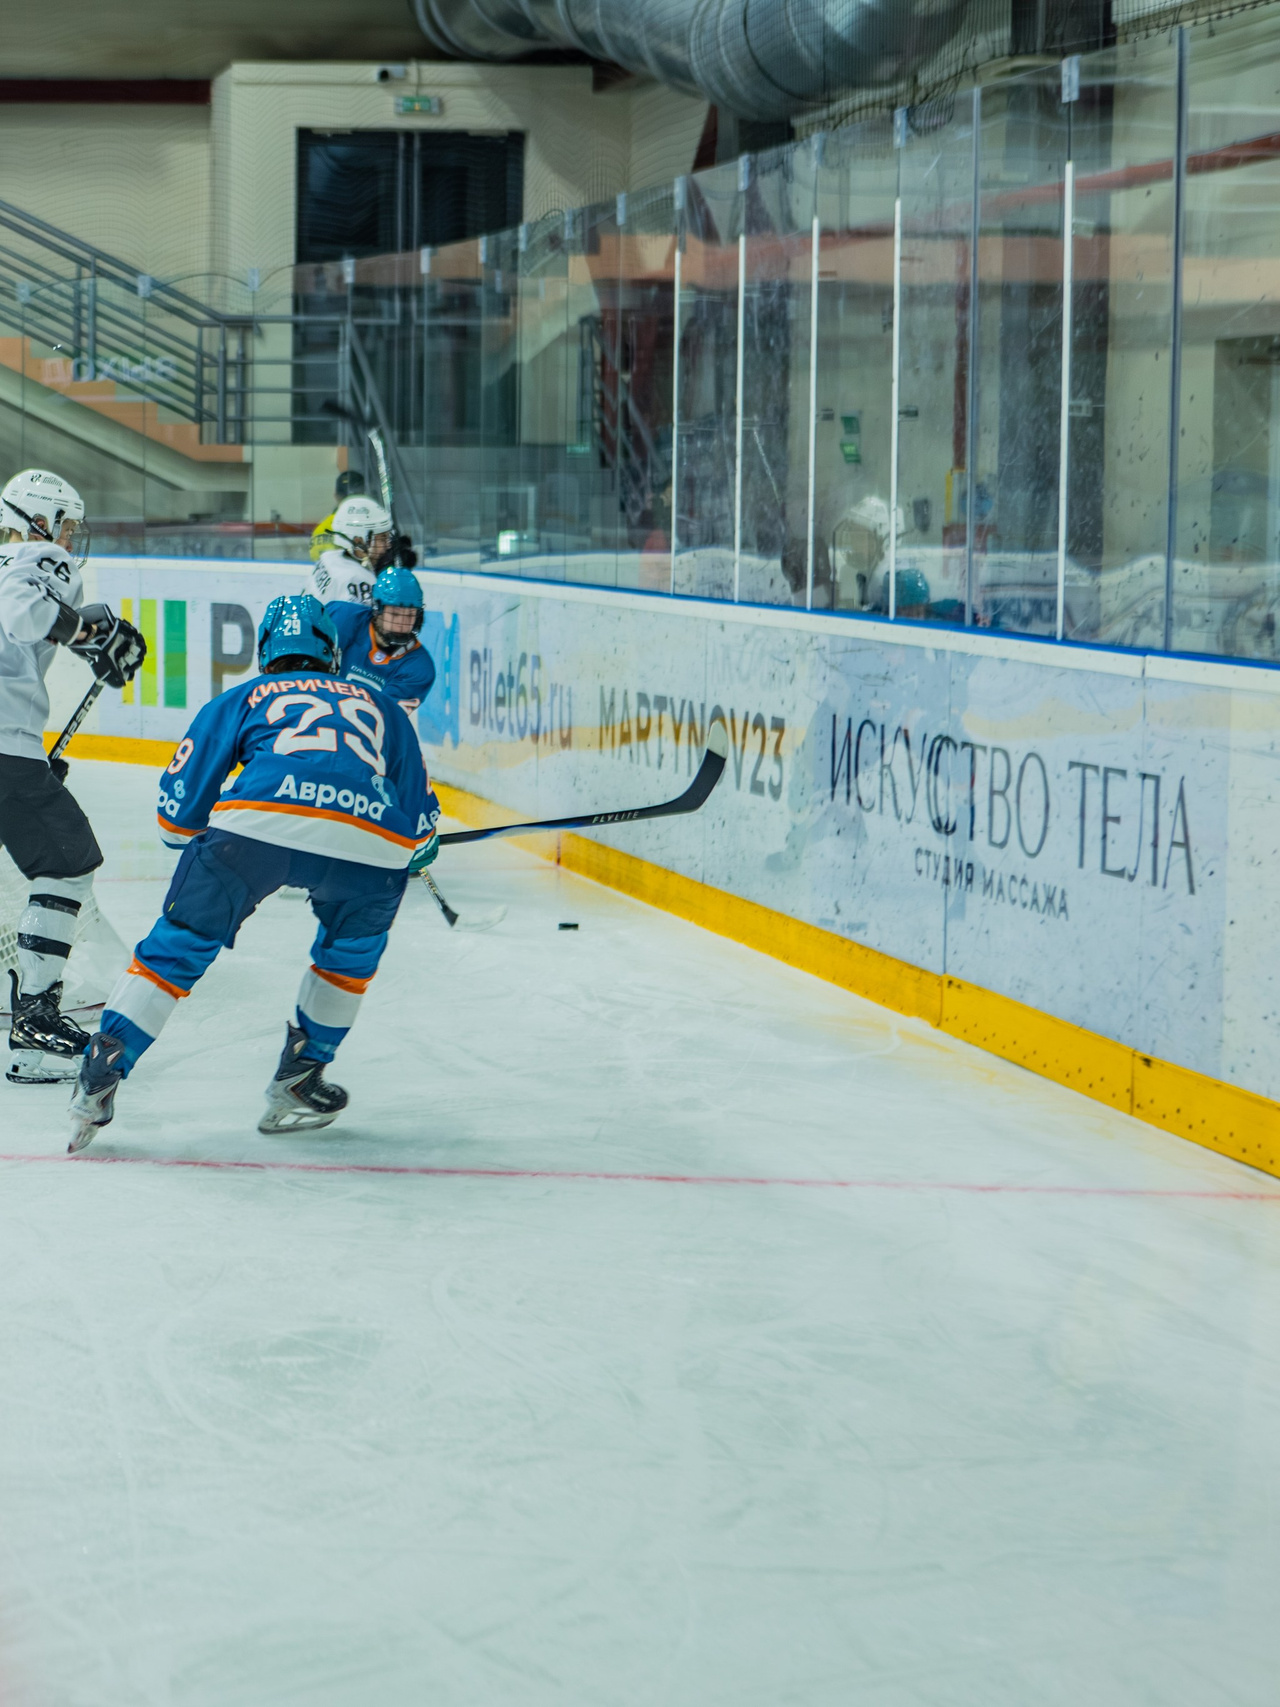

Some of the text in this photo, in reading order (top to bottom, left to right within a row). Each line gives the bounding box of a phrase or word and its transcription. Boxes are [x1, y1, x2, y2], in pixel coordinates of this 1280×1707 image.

[283, 618, 302, 637] 29
[247, 679, 376, 709] КИРИЧЕН
[470, 648, 572, 752] Bilet65.ru
[266, 694, 386, 777] 29
[274, 775, 387, 822] Аврора
[592, 811, 640, 824] FLYLITE
[1068, 760, 1197, 896] ТЕЛА
[915, 847, 1070, 922] СТУДИЯ МАССАЖА
